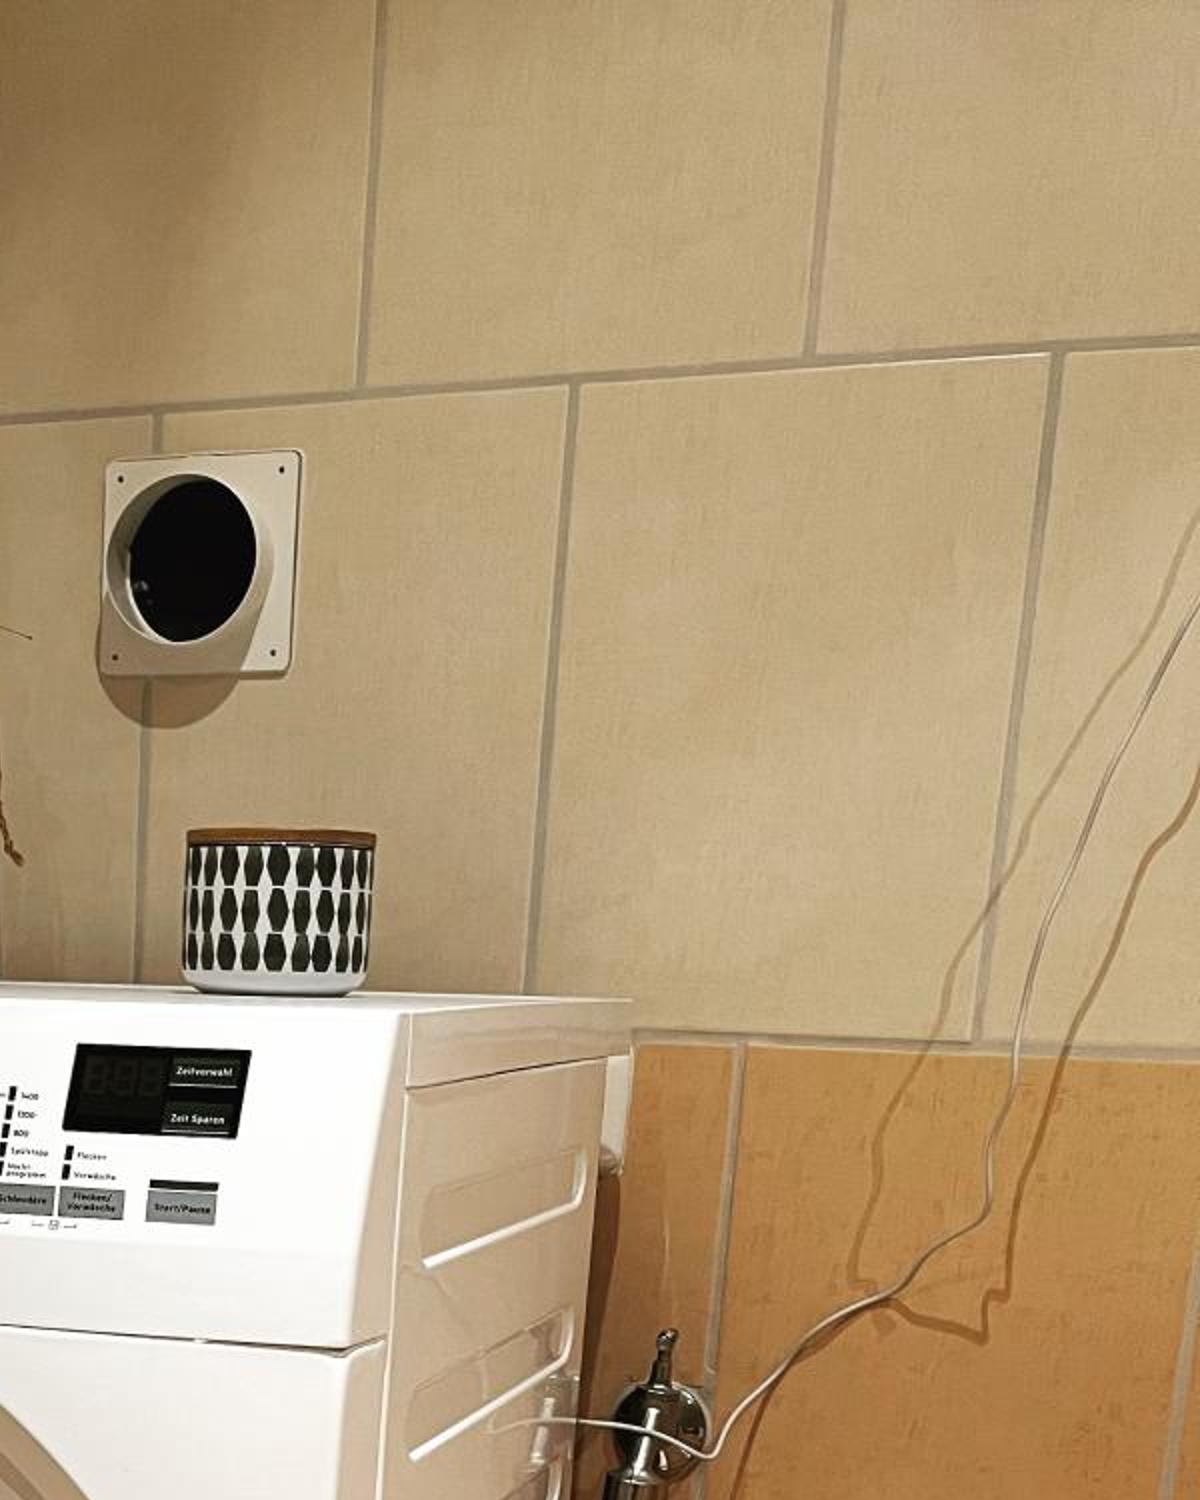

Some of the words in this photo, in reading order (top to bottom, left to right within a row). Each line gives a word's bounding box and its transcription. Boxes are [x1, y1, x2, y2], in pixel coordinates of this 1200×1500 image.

[175, 1066, 233, 1078] Zeitvorwahl
[169, 1113, 189, 1124] Zeit
[191, 1114, 225, 1126] Sparen
[154, 1203, 211, 1215] Start/Pause
